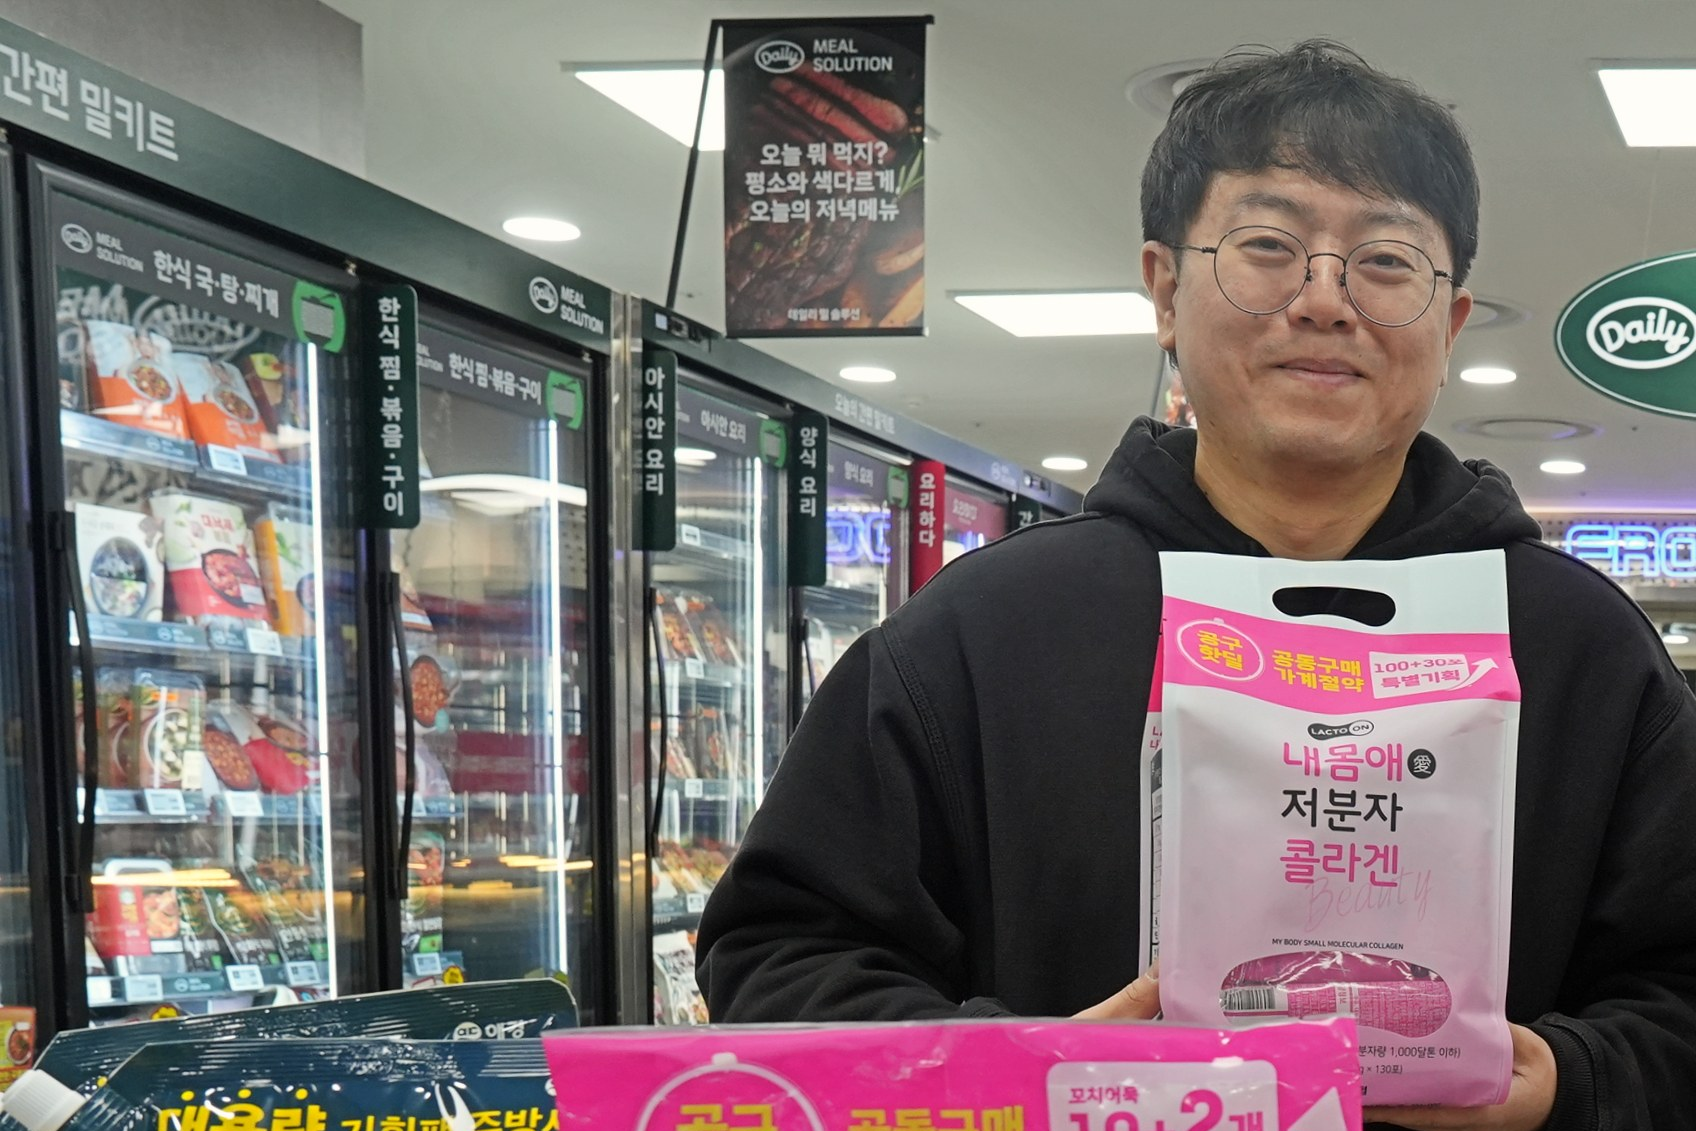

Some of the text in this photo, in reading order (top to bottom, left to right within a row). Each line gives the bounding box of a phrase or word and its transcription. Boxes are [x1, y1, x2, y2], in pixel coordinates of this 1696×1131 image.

[812, 38, 858, 54] MEAL
[812, 56, 893, 72] SOLUTION
[80, 78, 180, 162] 밀키트
[760, 141, 888, 167] 오늘 뭐 먹지?
[745, 170, 809, 195] 평소와
[750, 198, 900, 223] 오늘의 저녁메뉴
[153, 249, 192, 290] 한식
[560, 285, 586, 310] MEAL
[377, 296, 402, 349] 한식
[644, 366, 666, 497] 아시안 요리
[700, 408, 729, 439] 아시안
[799, 426, 819, 518] 양식 요리
[918, 472, 937, 548] 요리하다
[1197, 629, 1244, 651] 공구
[1198, 644, 1244, 672] 핫딜
[1272, 649, 1362, 677] 공동구매
[1273, 667, 1365, 693] 가계절약
[1380, 669, 1462, 690] 특별기획
[1282, 741, 1404, 784] 내몸애
[1280, 787, 1404, 833] 저분자
[1279, 837, 1401, 888] 콜라겐
[1271, 938, 1404, 951] MY BODY SMALL MOLECULAR COLLAGEN
[1390, 1045, 1462, 1059] 1,000달톤 이하)
[1374, 1063, 1403, 1075] 130포)
